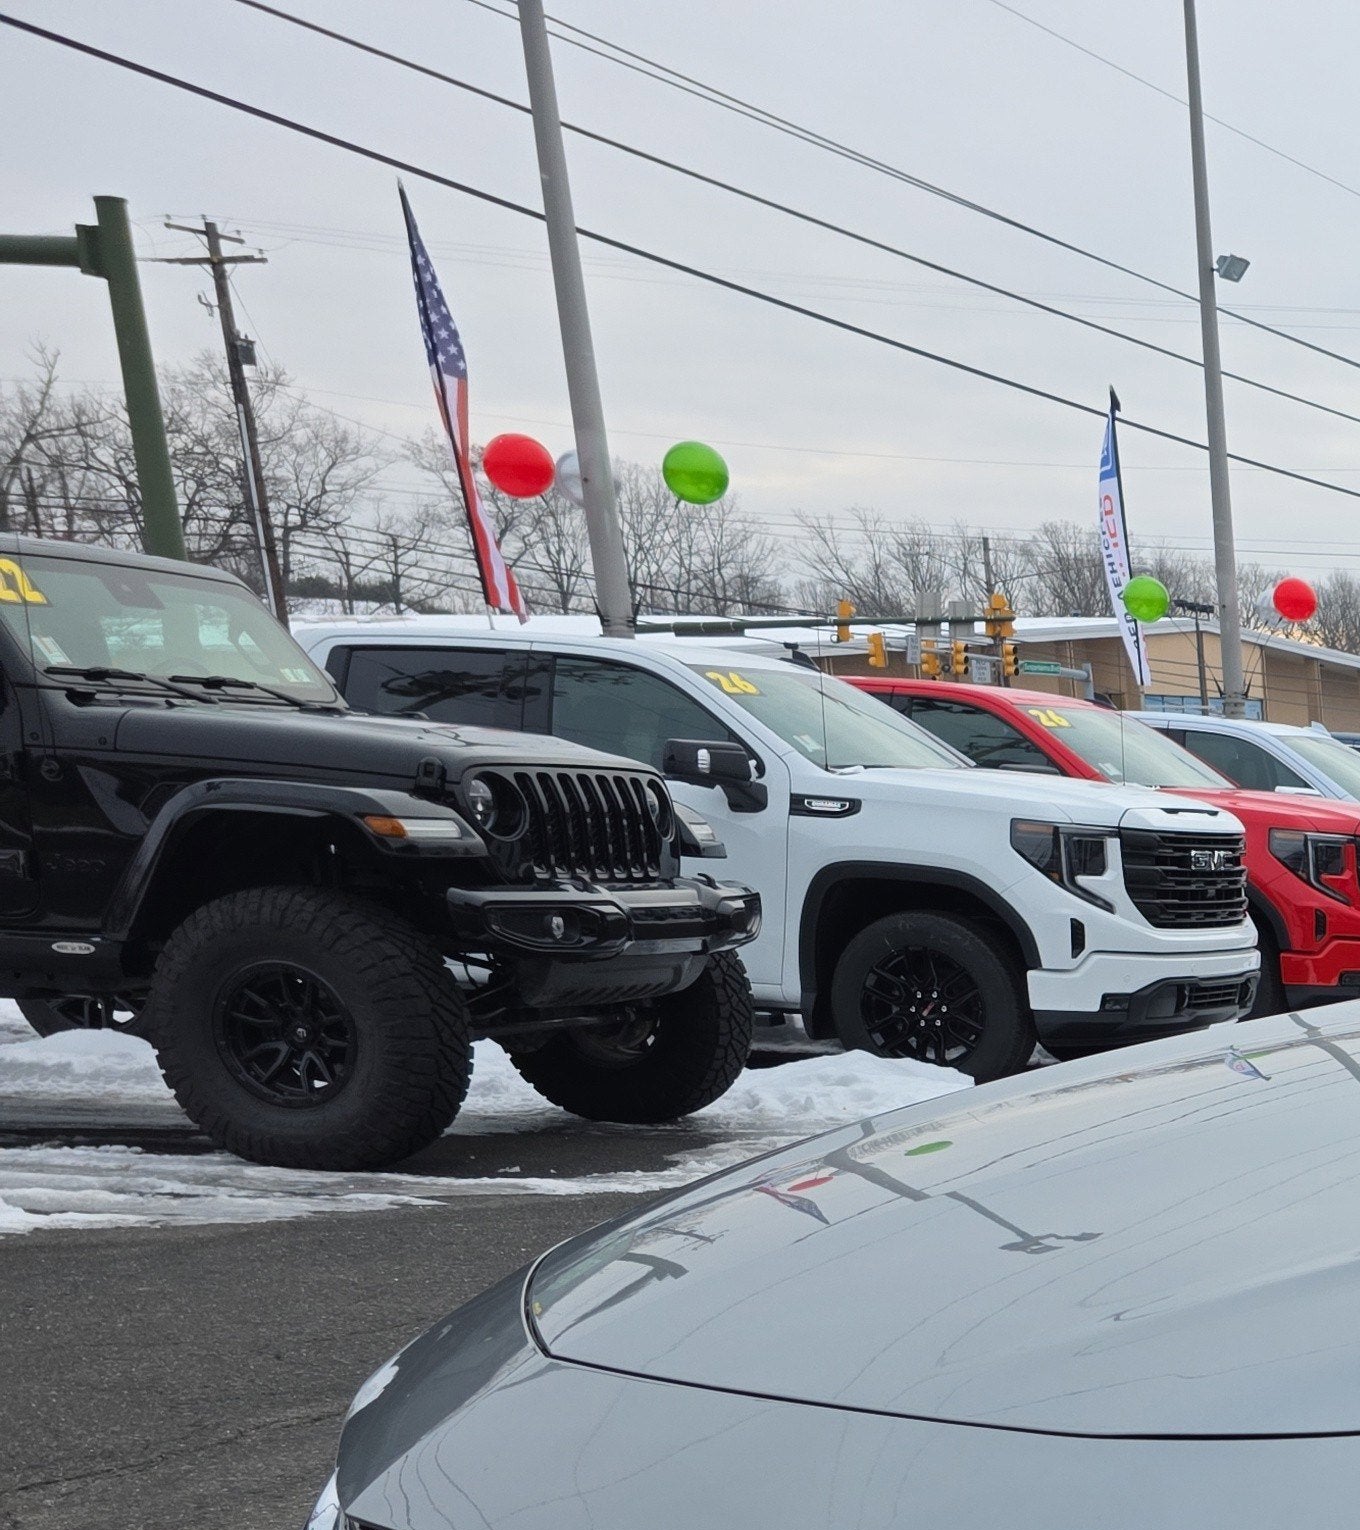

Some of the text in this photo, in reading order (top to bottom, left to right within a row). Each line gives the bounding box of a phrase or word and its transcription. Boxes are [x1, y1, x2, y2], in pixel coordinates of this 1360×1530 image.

[0, 558, 48, 604] 2
[705, 671, 760, 694] 26
[1028, 709, 1072, 727] 26
